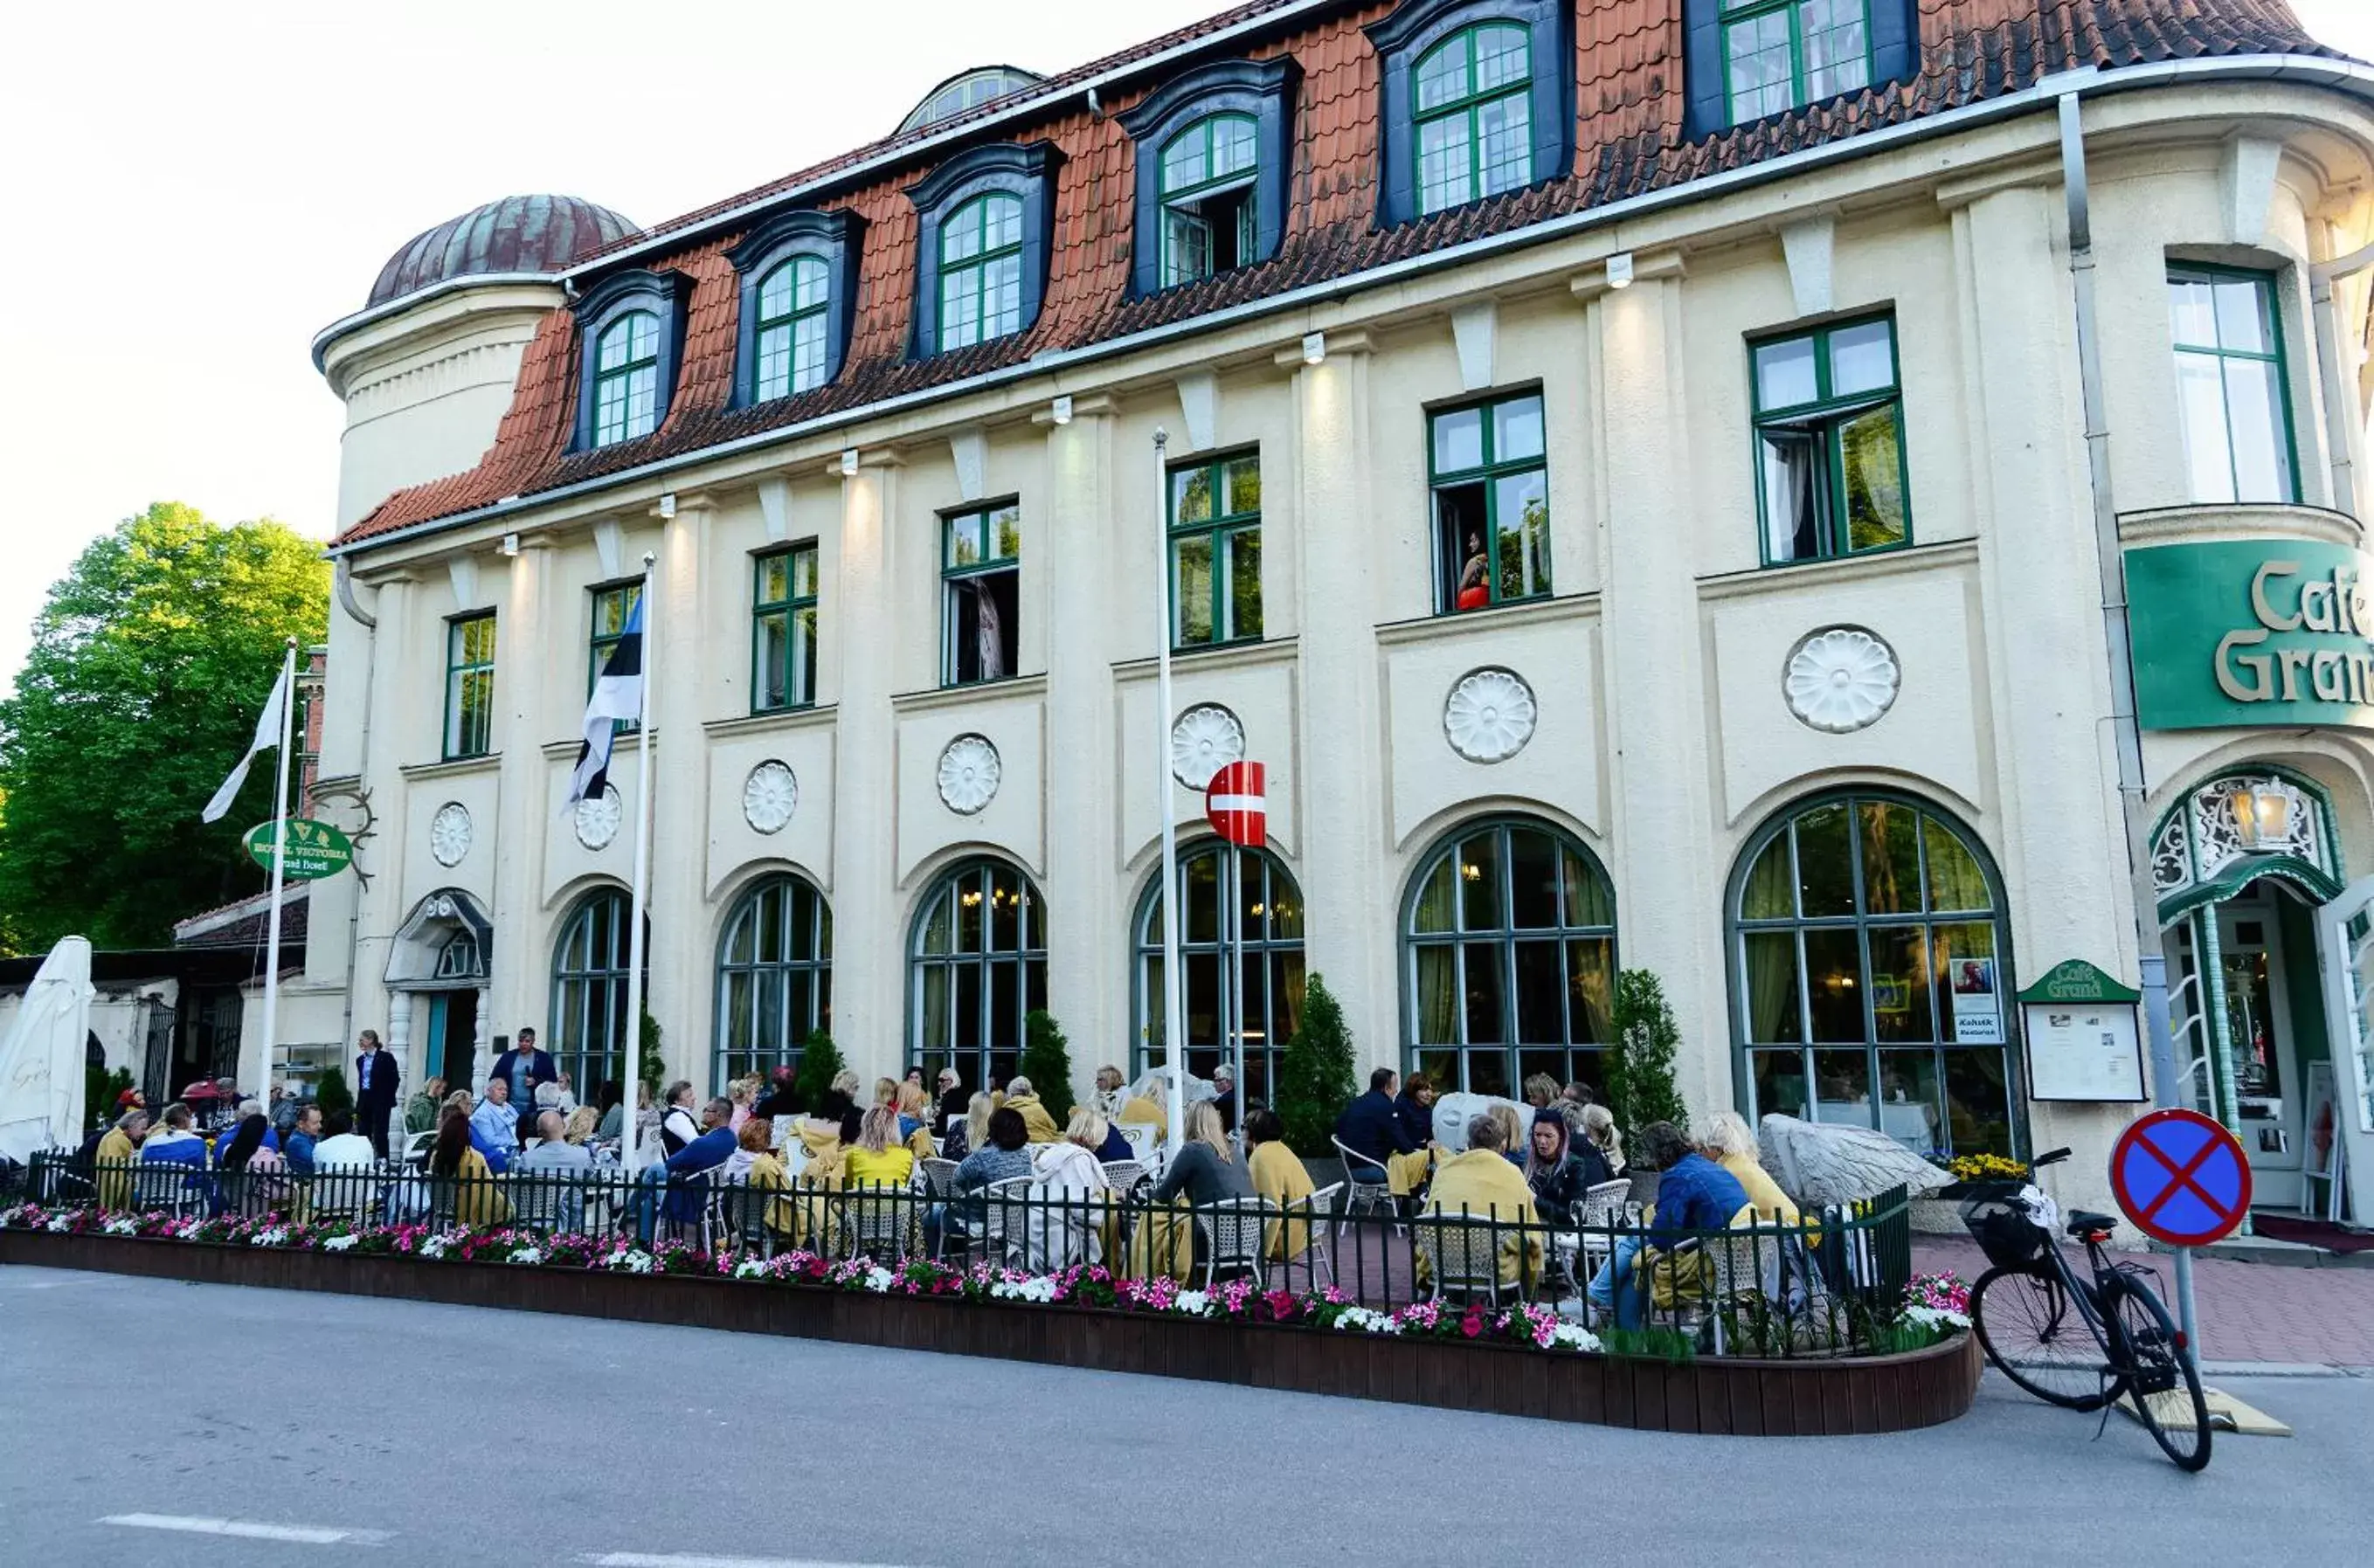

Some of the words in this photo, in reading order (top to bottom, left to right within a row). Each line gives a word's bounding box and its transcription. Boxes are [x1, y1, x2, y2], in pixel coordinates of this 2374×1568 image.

[2215, 628, 2374, 704] Gran
[295, 846, 349, 860] VICTORIA
[2056, 964, 2094, 981] Café
[2047, 977, 2102, 998] Grand
